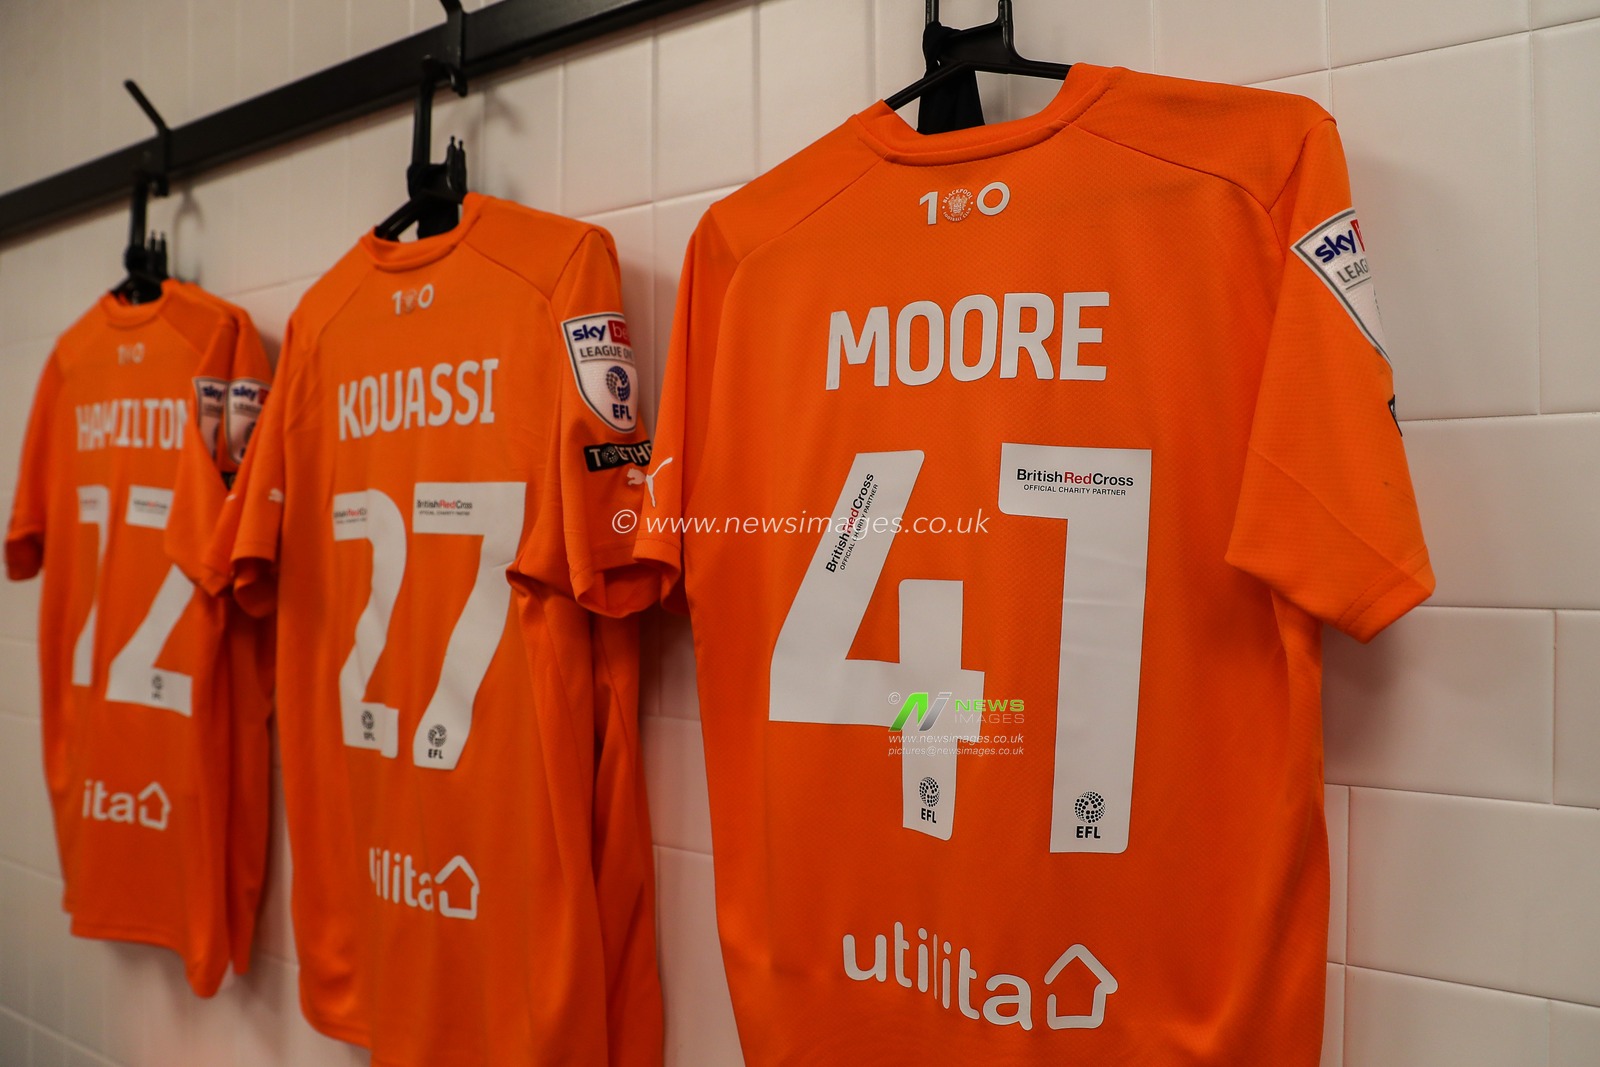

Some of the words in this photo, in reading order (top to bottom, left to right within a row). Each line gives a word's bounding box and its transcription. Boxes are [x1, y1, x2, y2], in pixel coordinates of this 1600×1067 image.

[942, 188, 973, 204] BLACKPOOL
[1314, 229, 1357, 263] sky
[572, 324, 606, 342] sky
[825, 291, 1110, 391] MOORE
[580, 345, 622, 359] LEAGUE
[338, 358, 499, 442] KOUASSI
[612, 403, 632, 420] EFL
[75, 398, 189, 452] HAMILTON
[1016, 468, 1134, 487] BritishRedCross
[862, 484, 879, 514] PARTNER
[1023, 484, 1057, 493] OFFICIAL
[1058, 486, 1091, 495] CHARITY
[1092, 488, 1126, 497] PARTNER
[331, 481, 528, 770] 27
[769, 443, 1152, 854] 41
[428, 748, 443, 760] EFL
[920, 807, 937, 824] EFL
[1075, 825, 1101, 839] EFL
[842, 921, 1034, 1031] utilita
